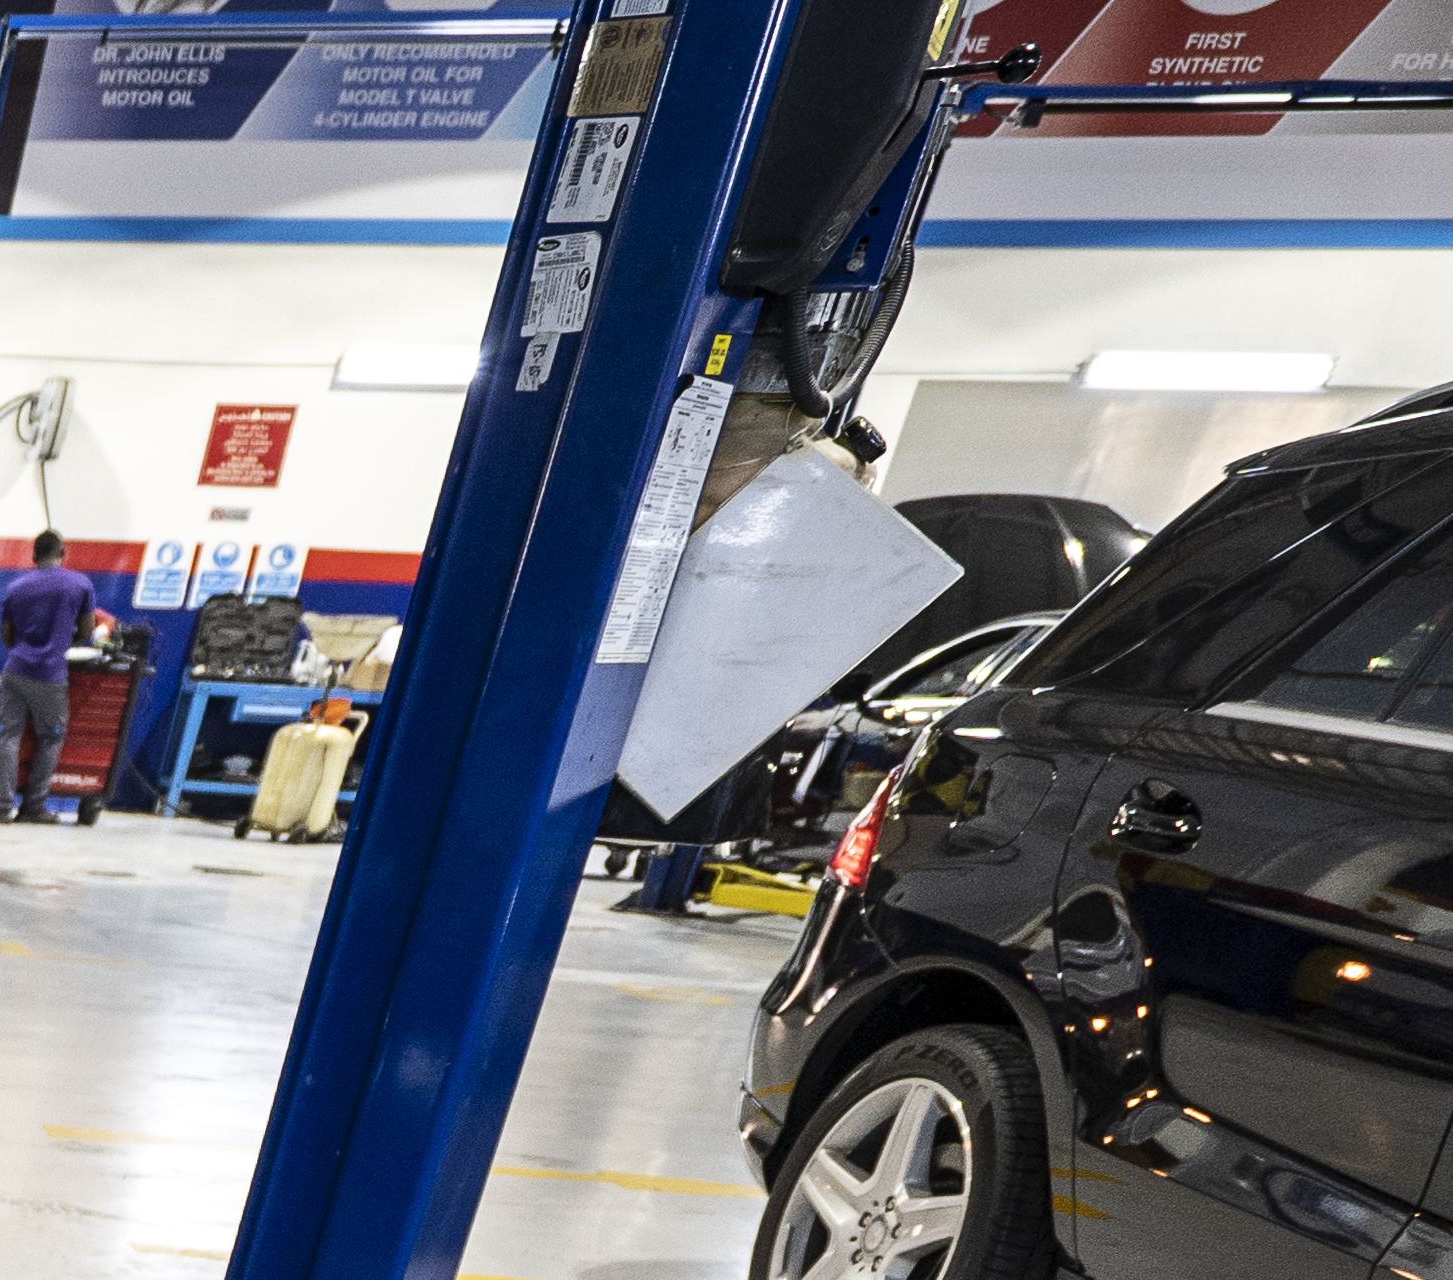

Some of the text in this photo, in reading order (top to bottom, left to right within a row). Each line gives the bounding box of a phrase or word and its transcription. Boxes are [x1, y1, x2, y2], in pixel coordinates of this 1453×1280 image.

[1185, 33, 1246, 50] FIRST
[91, 46, 226, 63] DR. JOHN ELLIS
[323, 45, 517, 60] ONLY RECOMMENDED
[1149, 56, 1264, 75] SYNTHETIC
[1391, 53, 1438, 71] FOR
[98, 68, 210, 84] INTRODUCES
[342, 67, 483, 83] MOTOR OIL FOR
[102, 90, 195, 107] MOTOR OIL
[339, 89, 474, 106] MODEL T VALVE
[314, 111, 489, 127] 4-CYLINDER ENGINE
